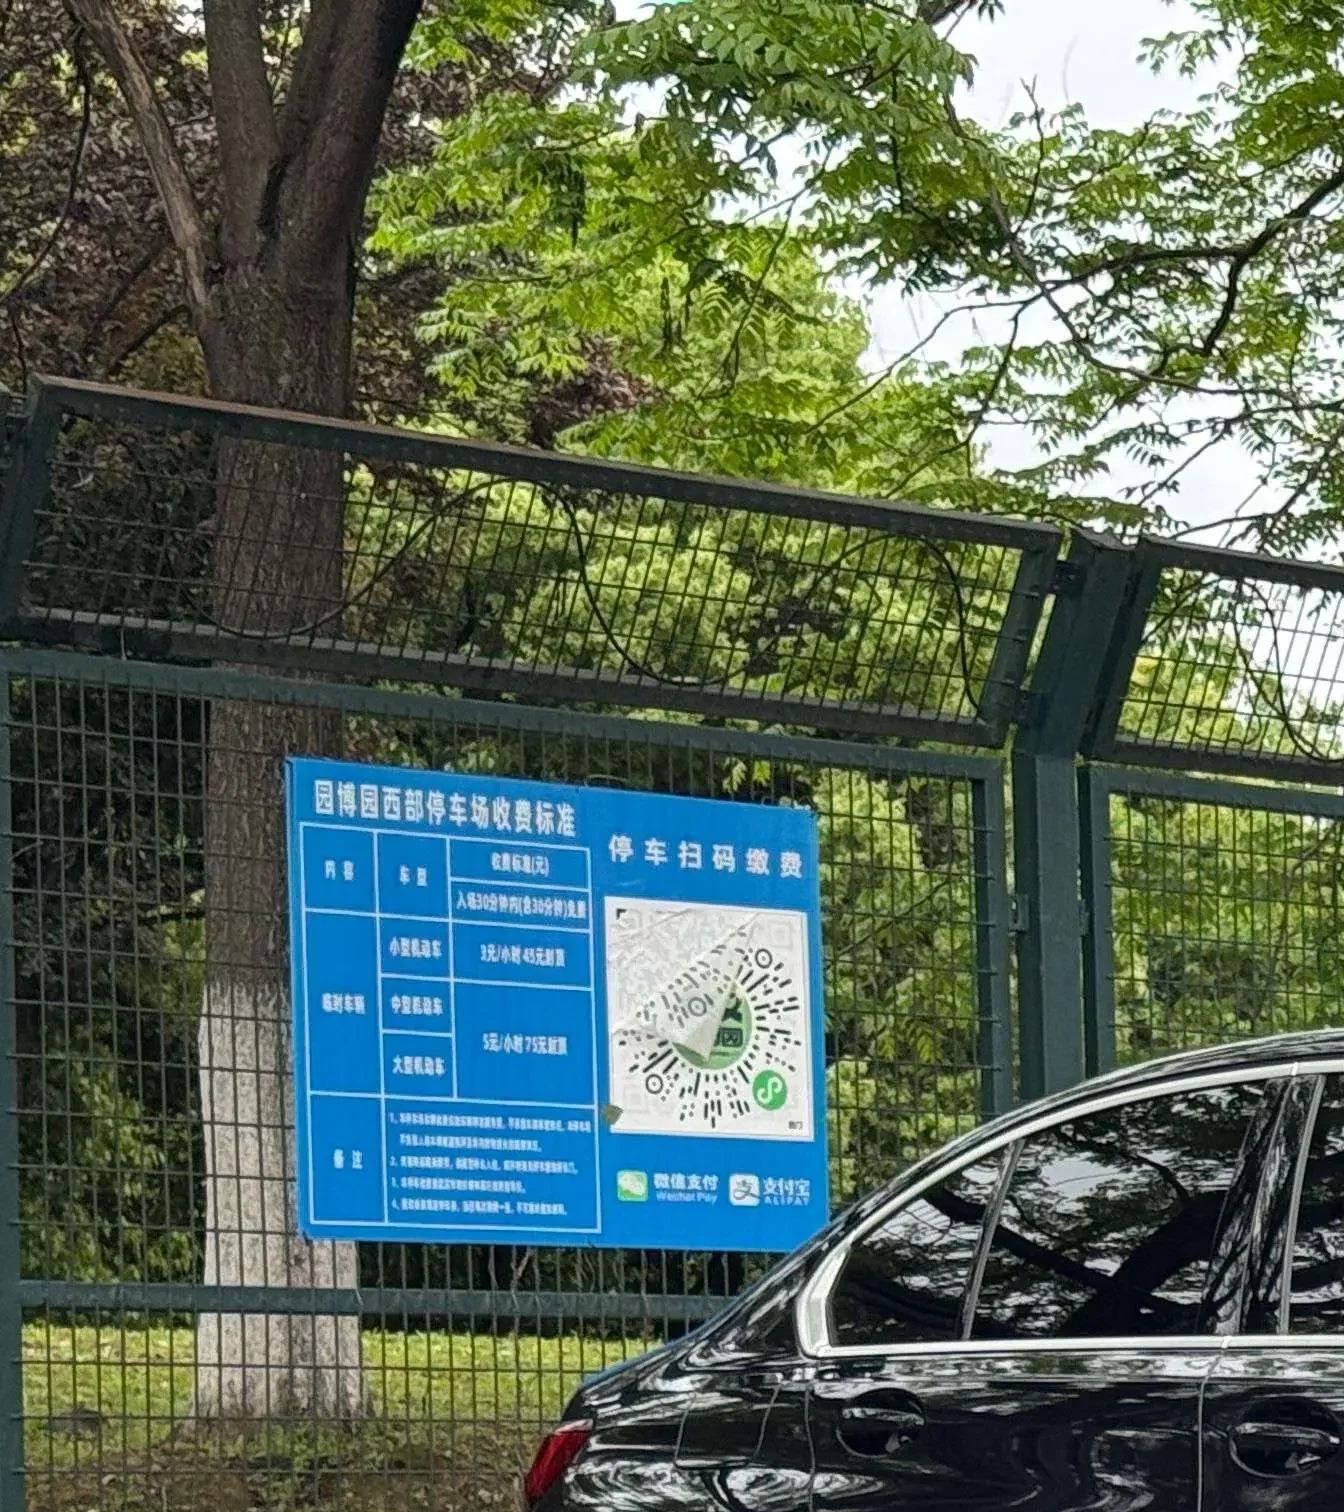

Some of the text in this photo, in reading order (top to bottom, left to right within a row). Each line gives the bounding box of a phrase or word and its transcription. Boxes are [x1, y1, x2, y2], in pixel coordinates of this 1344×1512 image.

[314, 779, 577, 837] 园博园西部停车场收费标准
[608, 833, 803, 879] 停车扫码缴费
[653, 1173, 719, 1191] 微信支付
[764, 1176, 811, 1197] 支付宝
